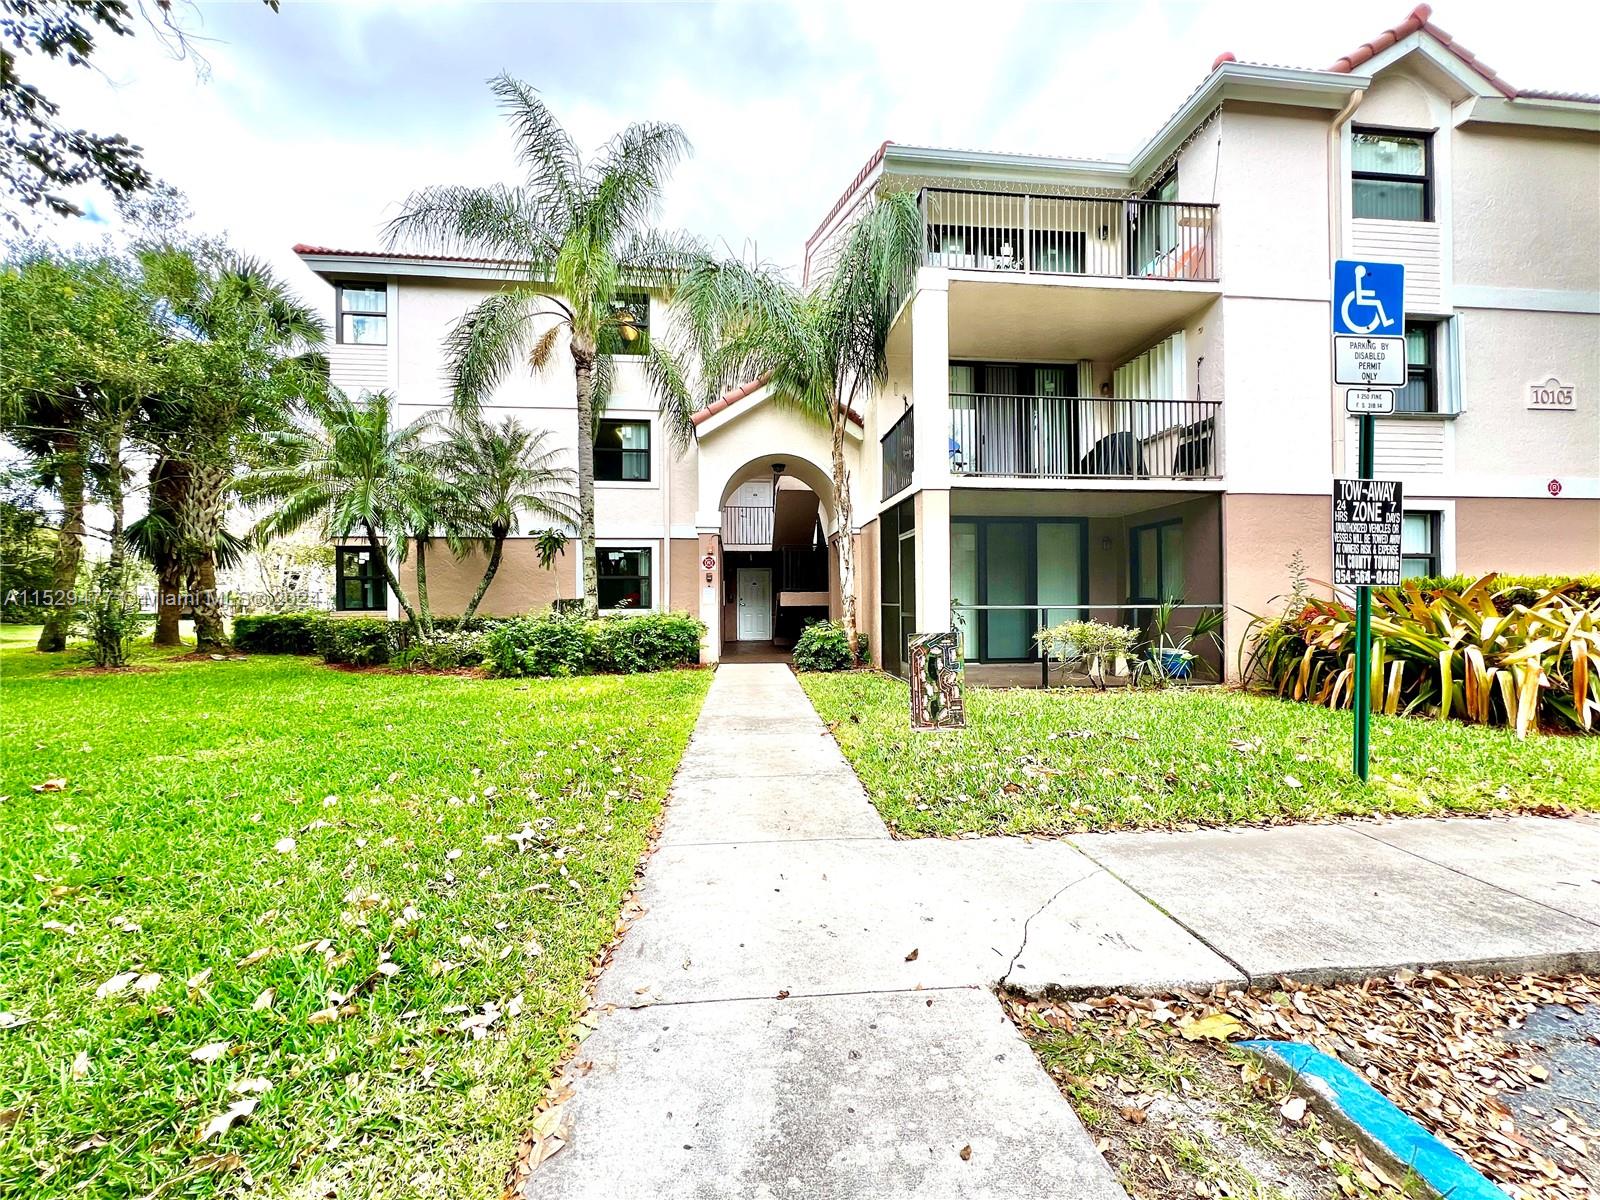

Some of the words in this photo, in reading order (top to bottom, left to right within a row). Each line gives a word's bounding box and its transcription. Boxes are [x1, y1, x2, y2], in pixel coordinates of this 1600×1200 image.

[1350, 341, 1376, 350] PARKING
[1355, 352, 1385, 360] DISABLED
[1359, 362, 1381, 370] PERMIT
[1362, 372, 1377, 380] ONLY
[1533, 389, 1572, 405] 10105
[1340, 480, 1396, 502] TOW-AWAY
[1336, 500, 1346, 511] 24
[1390, 502, 1397, 512] 7
[1334, 511, 1348, 522] HRS
[1352, 501, 1383, 522] ZONE
[1386, 512, 1400, 524] DAYS
[1369, 523, 1391, 534] VEHICLES
[1392, 524, 1400, 534] OR
[1334, 533, 1352, 543] VESSELS
[1353, 534, 1363, 543] WILL
[1364, 534, 1371, 543] BE
[1372, 534, 1388, 544] TOWED
[1360, 544, 1372, 554] RISK
[1373, 545, 1377, 554] &
[1378, 545, 1399, 555] EXPENSE
[1336, 555, 1346, 569] ALL
[1347, 555, 1372, 569] COUNTY
[1374, 555, 1399, 570] TOWING
